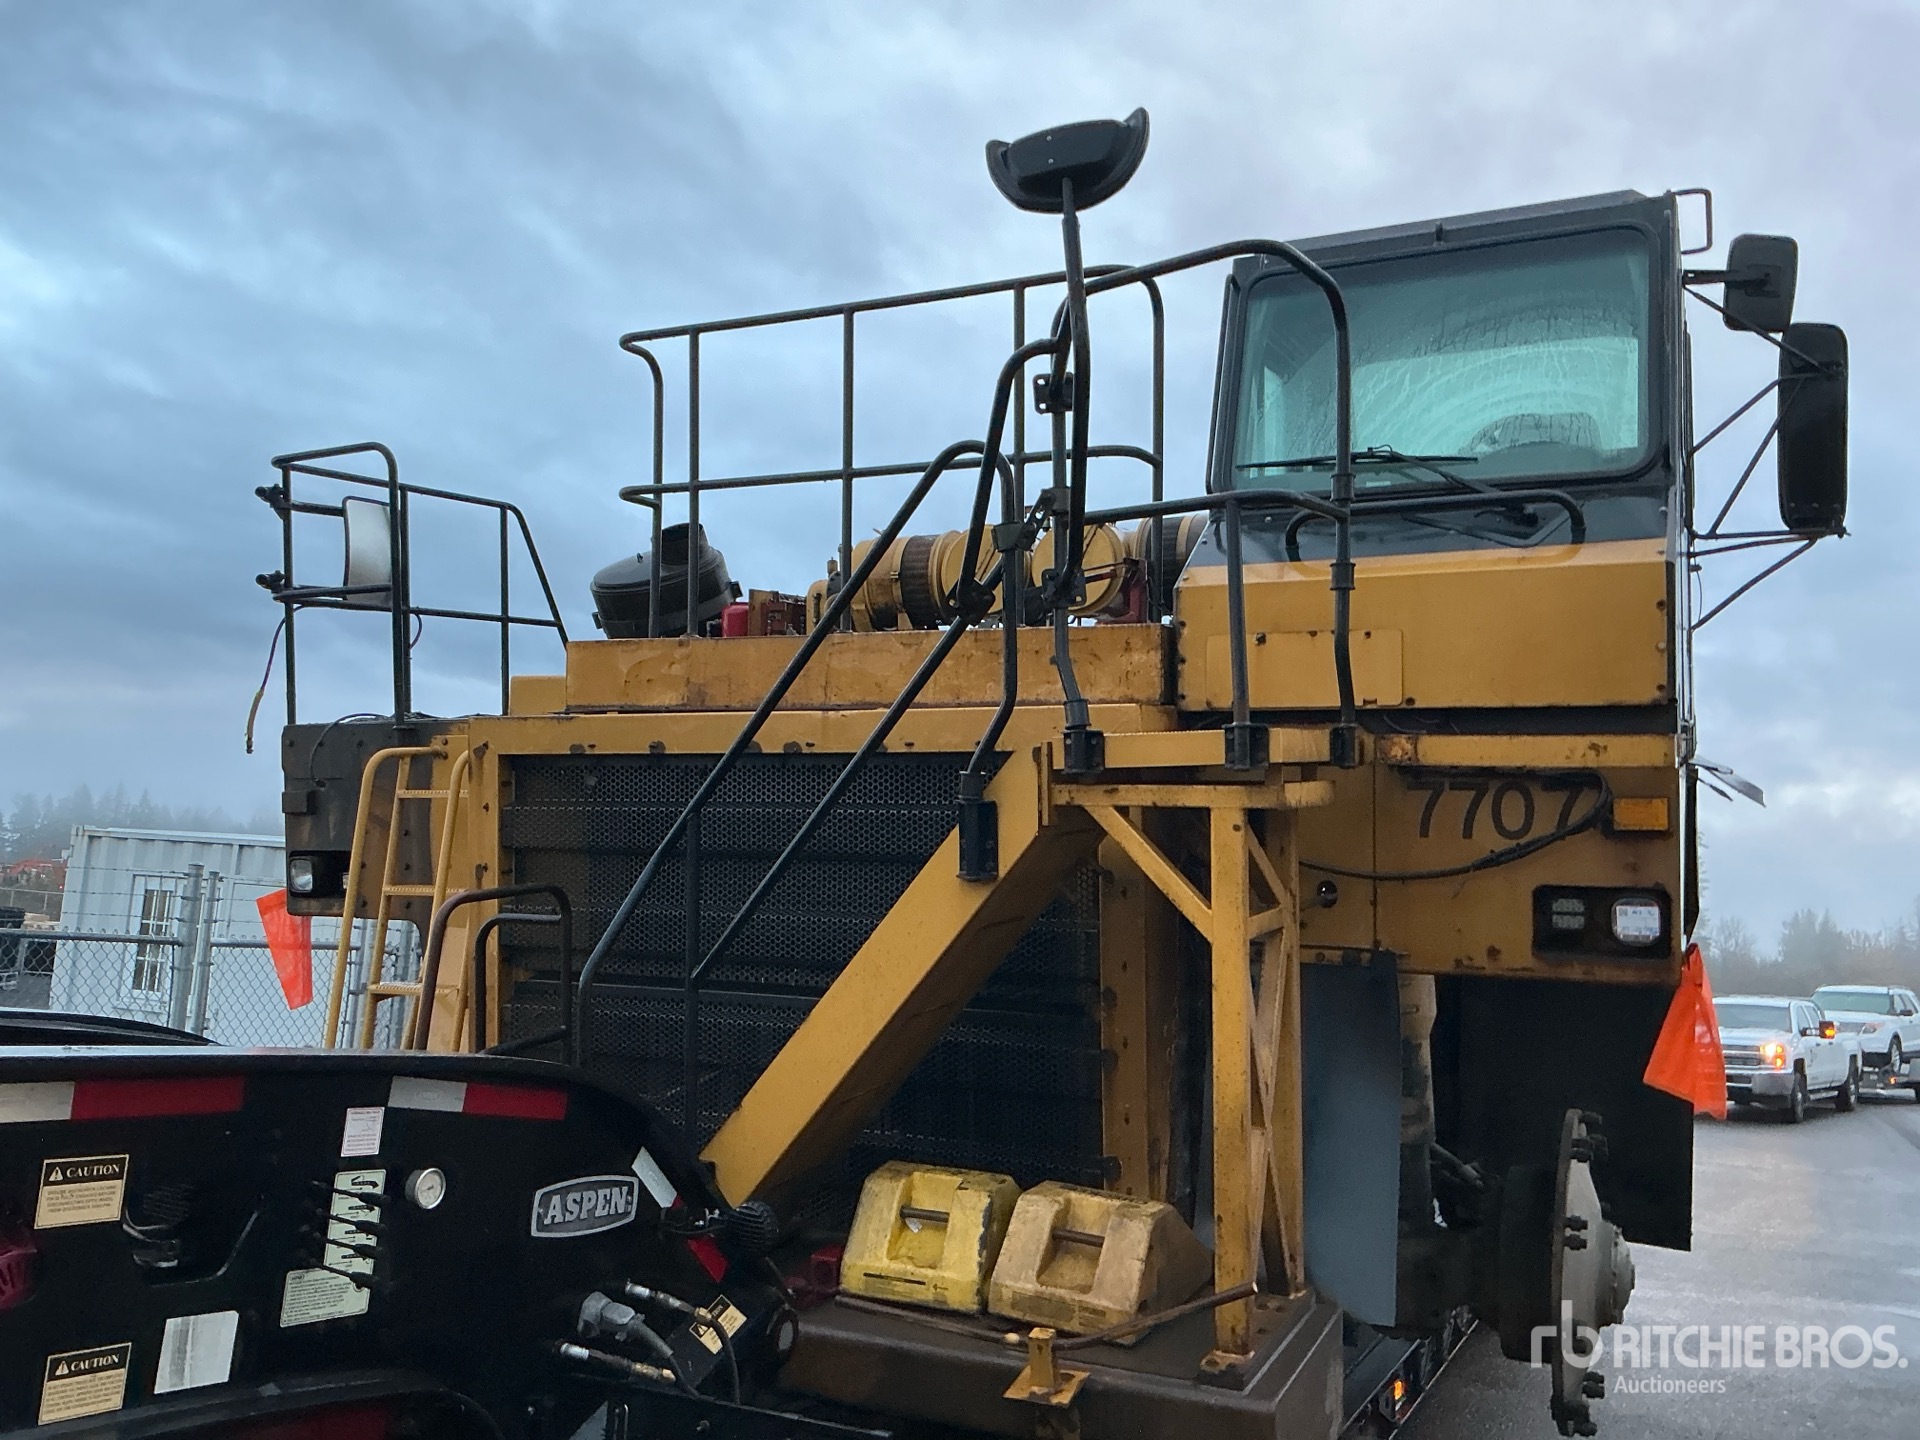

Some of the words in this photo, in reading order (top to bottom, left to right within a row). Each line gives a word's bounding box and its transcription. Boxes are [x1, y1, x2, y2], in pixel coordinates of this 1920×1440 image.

[66, 1164, 120, 1178] CAUTION
[543, 1186, 629, 1225] ASPEN
[70, 1354, 120, 1371] CAUTION
